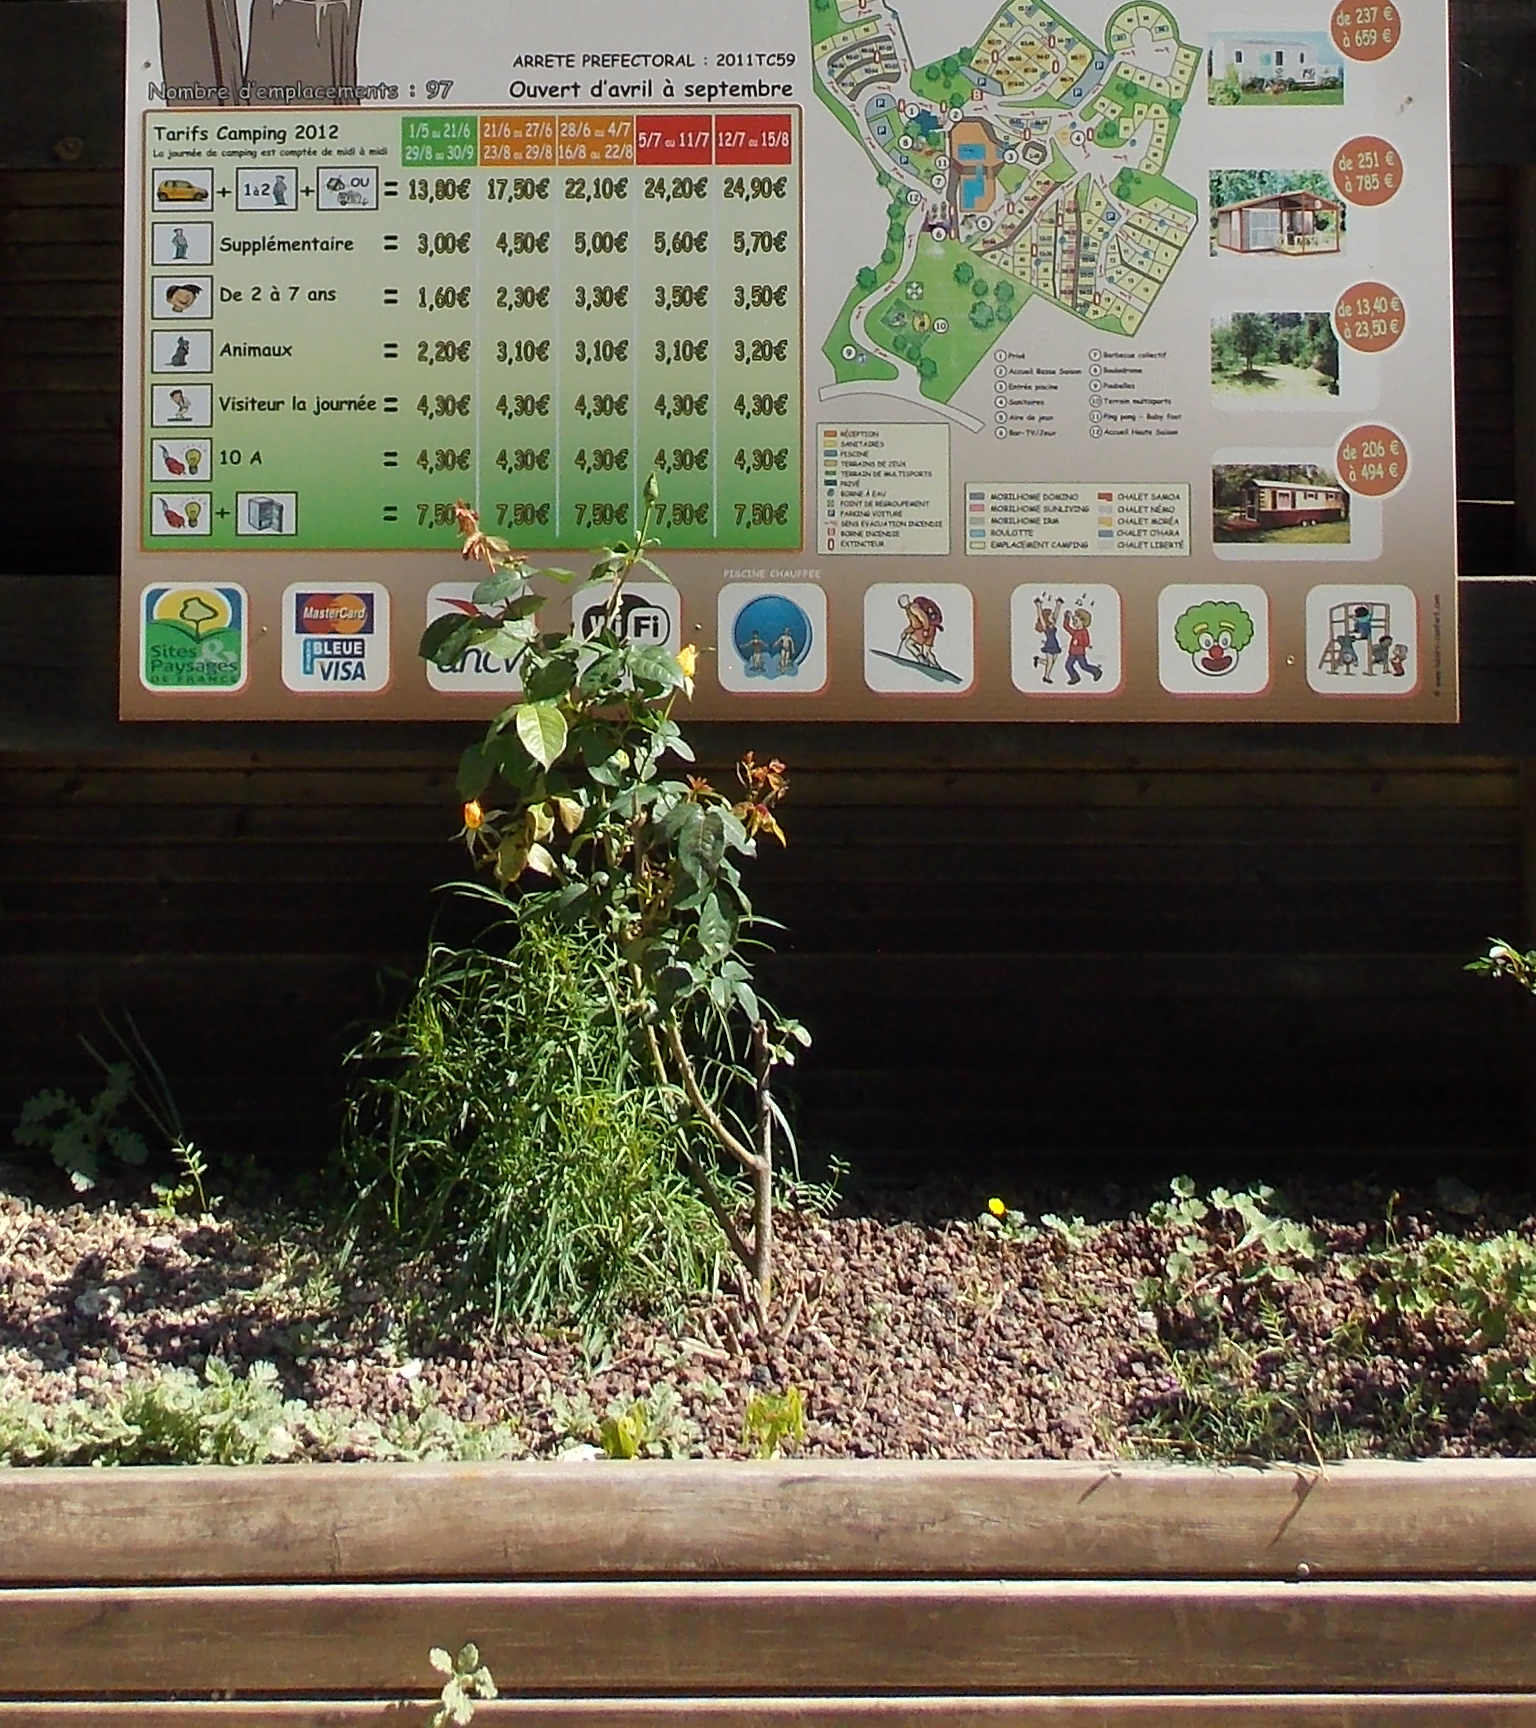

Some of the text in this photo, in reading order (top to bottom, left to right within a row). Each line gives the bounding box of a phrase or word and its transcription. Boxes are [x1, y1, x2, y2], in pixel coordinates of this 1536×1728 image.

[1337, 6, 1393, 25] de 237 €
[1342, 28, 1392, 47] à 659 €
[513, 53, 796, 68] ARRETE PREFECTORAL 2011TC59
[148, 80, 454, 101] Nombre d'emplacements 97
[509, 78, 793, 102] Ouvert d'avril à septembre
[154, 125, 338, 144] Tarifs Camping 2012
[410, 122, 470, 138] 1/5 21/6
[484, 122, 552, 138] 21/6 27/6
[560, 122, 631, 137] 28/6 4/7
[638, 132, 662, 148] 5/7
[679, 132, 710, 147] 11/7
[718, 132, 745, 147] 12/7
[762, 132, 789, 147] 15/8
[222, 150, 257, 158] camping
[280, 148, 317, 157] comptée
[322, 147, 332, 156] de
[406, 145, 474, 160] 29/8 30/9
[484, 145, 552, 160] 23/8 29/8
[559, 144, 633, 160] 16/8 22/8
[1339, 151, 1395, 170] de 251 €
[261, 184, 270, 196] 2
[350, 177, 369, 187] OU
[409, 177, 787, 203] 13,80€ 17,50€ 22,10€ 24,20€ 24,90€
[1345, 174, 1394, 192] à 785 €
[220, 231, 787, 257] Supplémentaire 3,00€ 4,50€ 5,00€ 5,60€ 5,70€
[220, 286, 787, 311] De 2 à 7 ans 1,60€ 2,30€ 3,30€ 3,50€ 3,50€
[1338, 296, 1400, 316] de 13,40 €
[1344, 320, 1400, 339] à 23,50 €
[219, 340, 788, 365] Animaux 2,20€ 3,10€ 3,10€ 3,10€ 3,20€
[219, 394, 788, 420] Visiteur la journée 4,30€ 4,30€ 4,30€ 4,30€ 4,30€
[1343, 440, 1399, 460] de 206 €
[219, 449, 788, 474] 10 A 4,30€ 4,30€ 4,30€ 4,30€ 4,30€
[1349, 462, 1398, 482] à 494 €
[417, 503, 788, 530] 7,50 7,50€ 7,50€ 7,50€ 7,50€
[304, 607, 366, 620] MasterCard
[150, 644, 197, 658] Sites
[314, 641, 362, 655] BLEUE
[150, 660, 237, 672] Paysages
[320, 661, 366, 681] VISA
